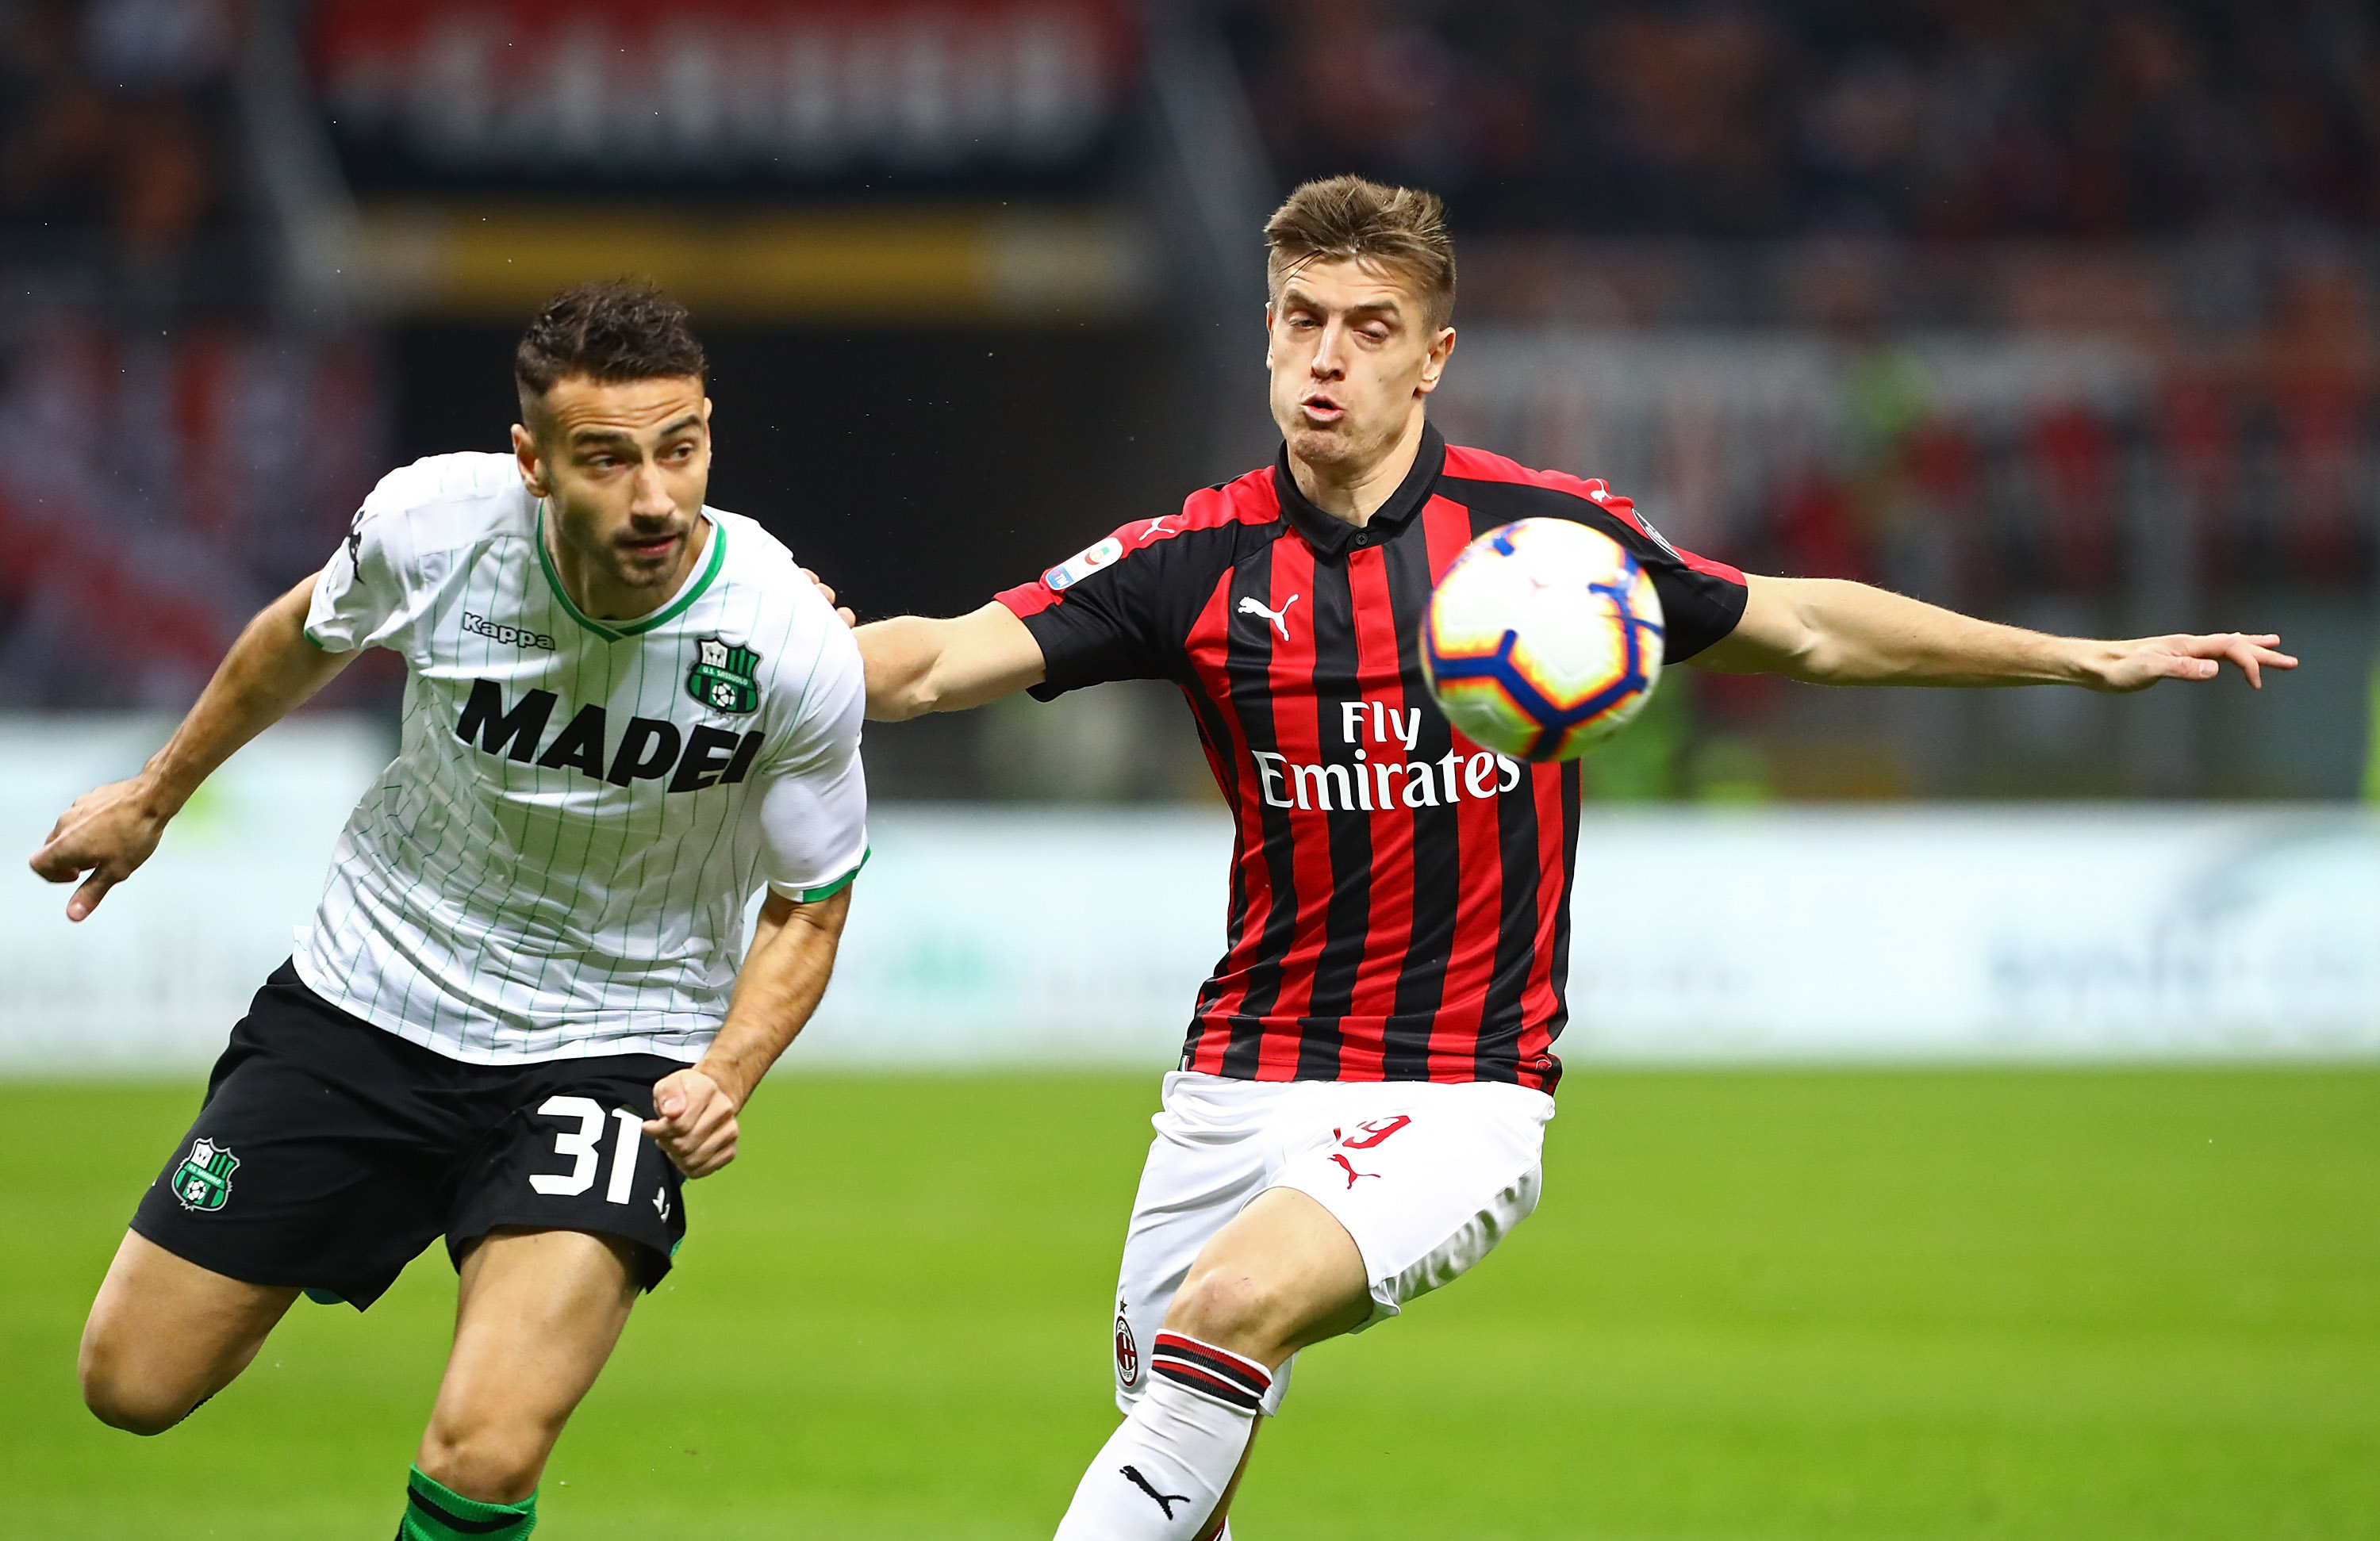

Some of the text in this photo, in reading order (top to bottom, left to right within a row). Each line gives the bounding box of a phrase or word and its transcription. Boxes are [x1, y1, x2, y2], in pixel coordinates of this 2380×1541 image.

[463, 611, 555, 650] Kappa
[456, 677, 766, 793] MAPEI
[1341, 701, 1422, 751] Fly
[1252, 748, 1521, 811] Emirates
[528, 1095, 644, 1206] 31
